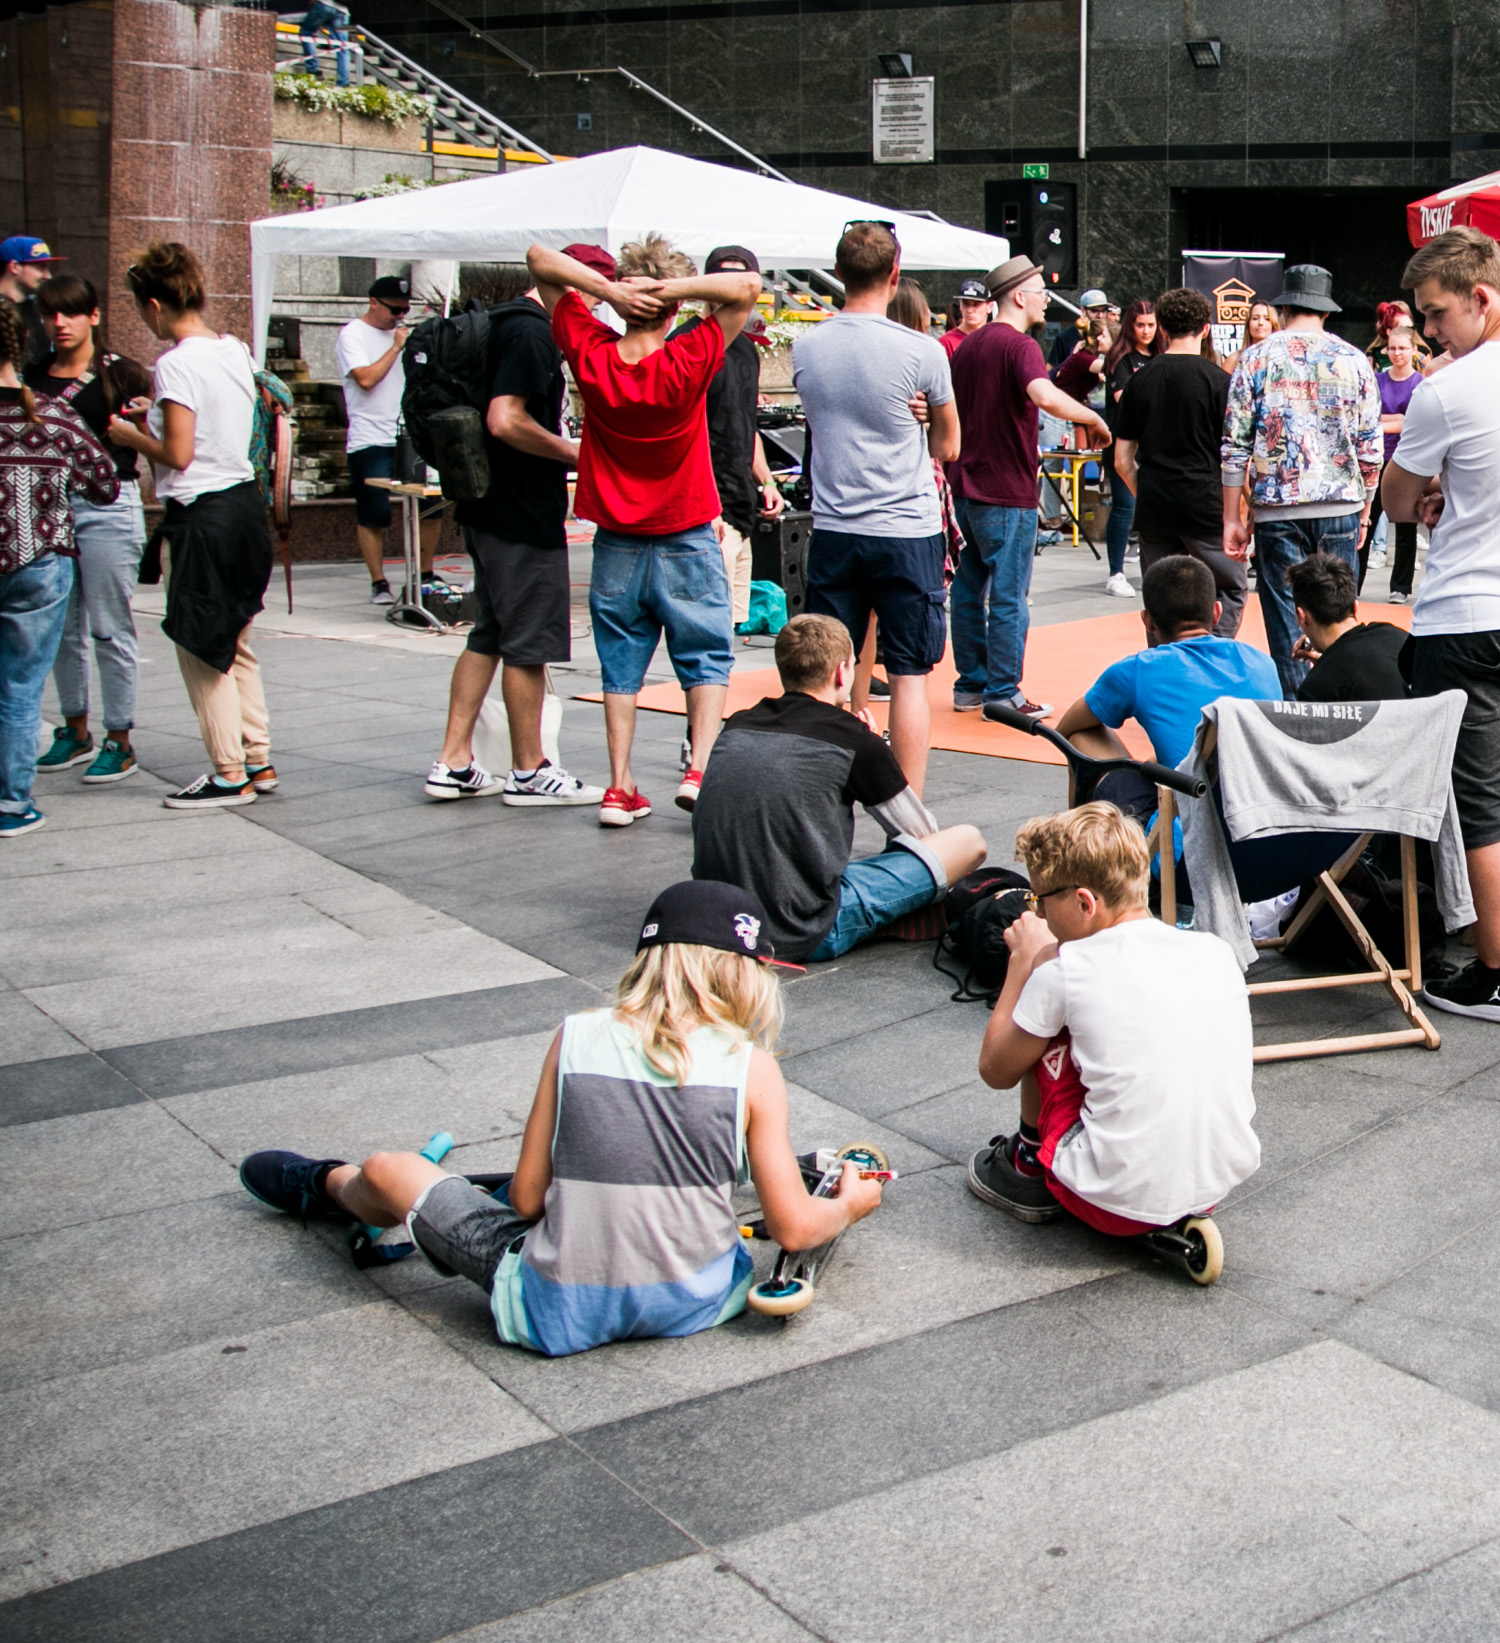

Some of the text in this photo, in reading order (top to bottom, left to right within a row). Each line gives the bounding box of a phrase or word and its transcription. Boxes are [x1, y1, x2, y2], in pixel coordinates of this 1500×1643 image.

[1211, 324, 1235, 338] HIP
[1273, 701, 1362, 722] DAJE MI SIŁĘ
